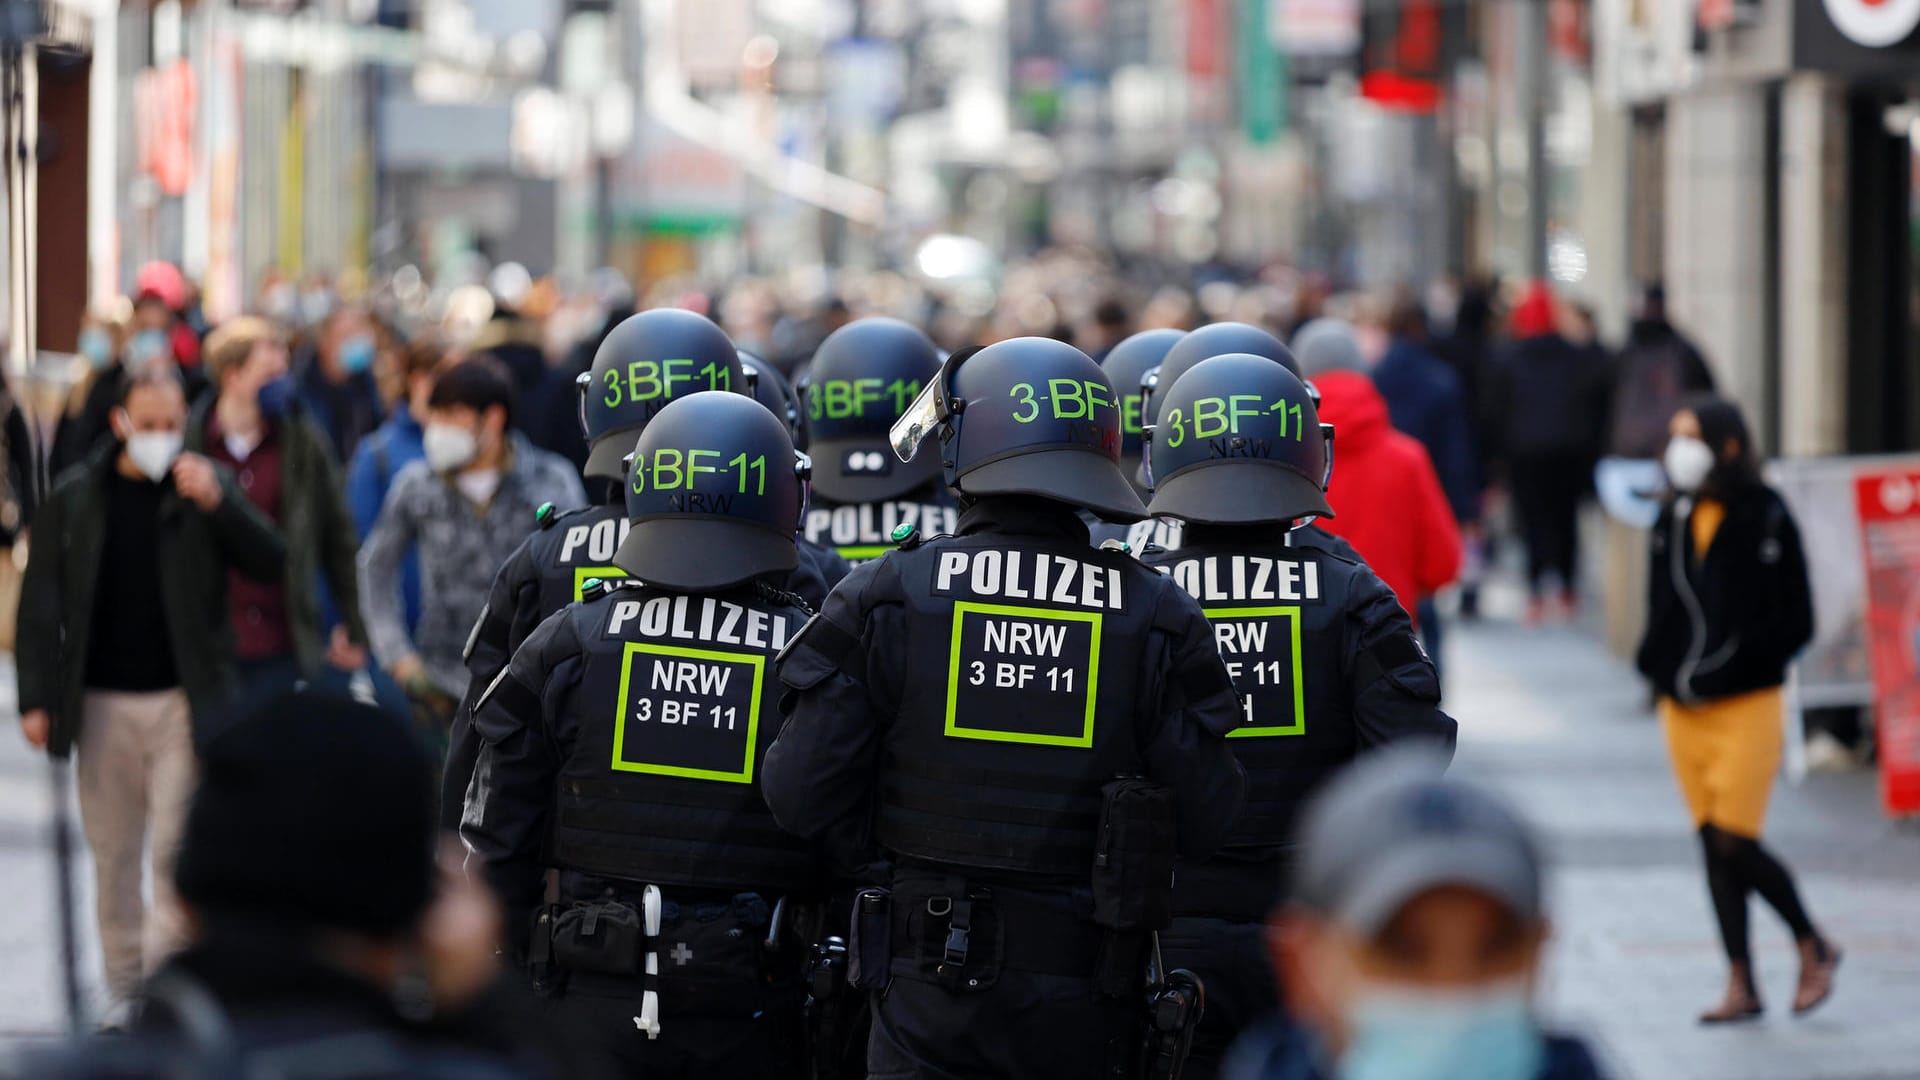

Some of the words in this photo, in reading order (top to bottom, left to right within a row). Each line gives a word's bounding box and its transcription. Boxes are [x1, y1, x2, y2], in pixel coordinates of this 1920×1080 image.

[603, 359, 731, 408] 3-BF-11
[1167, 394, 1303, 448] 3-BF-11
[632, 448, 766, 495] 3-BF-11
[937, 550, 1122, 609] POLIZEI
[1152, 555, 1319, 601] OLIZEI
[608, 596, 786, 650] POLIZEI
[983, 619, 1067, 657] NRW
[1214, 621, 1268, 654] RW
[651, 659, 732, 697] NRW
[969, 660, 985, 686] 3
[995, 662, 1036, 689] BF
[1046, 667, 1074, 692] 11
[1253, 661, 1280, 685] 11
[636, 697, 652, 721] 3
[660, 700, 700, 725] BF
[709, 705, 736, 730] 11
